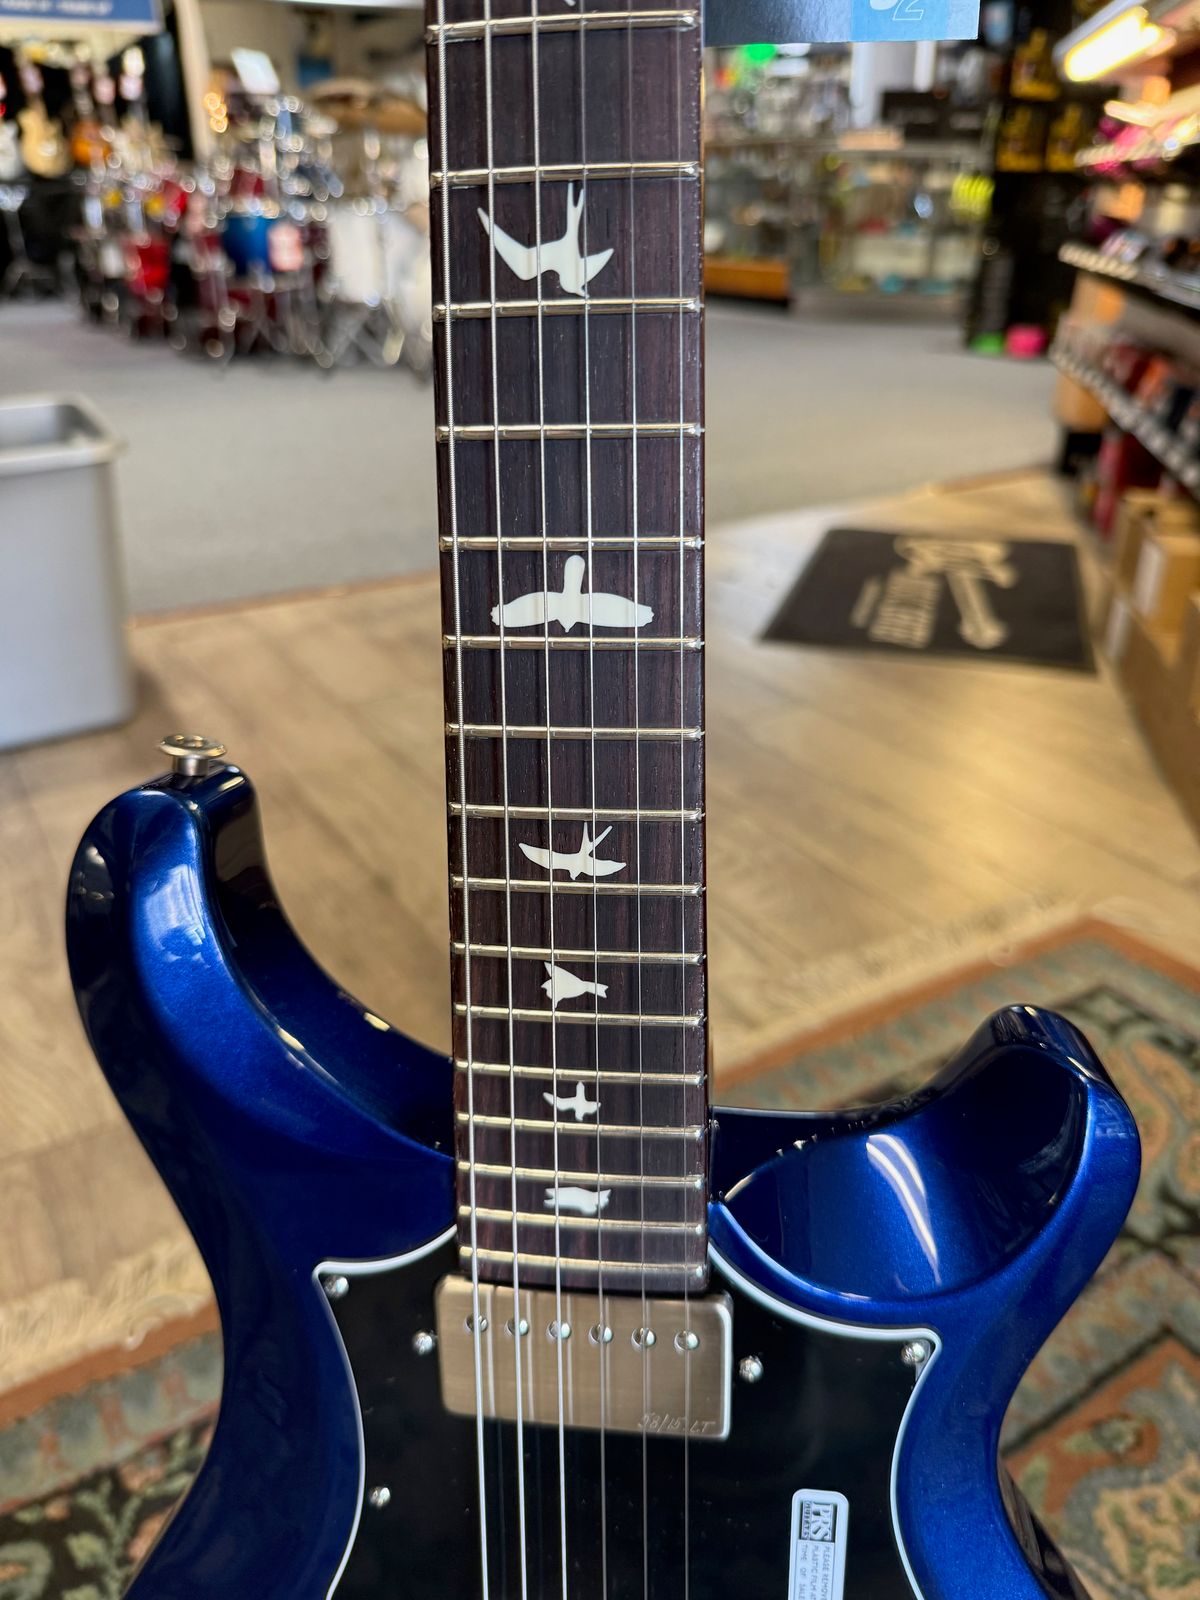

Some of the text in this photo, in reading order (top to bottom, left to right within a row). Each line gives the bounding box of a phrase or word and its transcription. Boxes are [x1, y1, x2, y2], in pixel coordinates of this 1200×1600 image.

[811, 1501, 831, 1541] PRS
[801, 1544, 809, 1561] TIME
[812, 1545, 820, 1573] PLASTIC
[822, 1545, 831, 1571] PLEASE
[800, 1567, 807, 1577] OF
